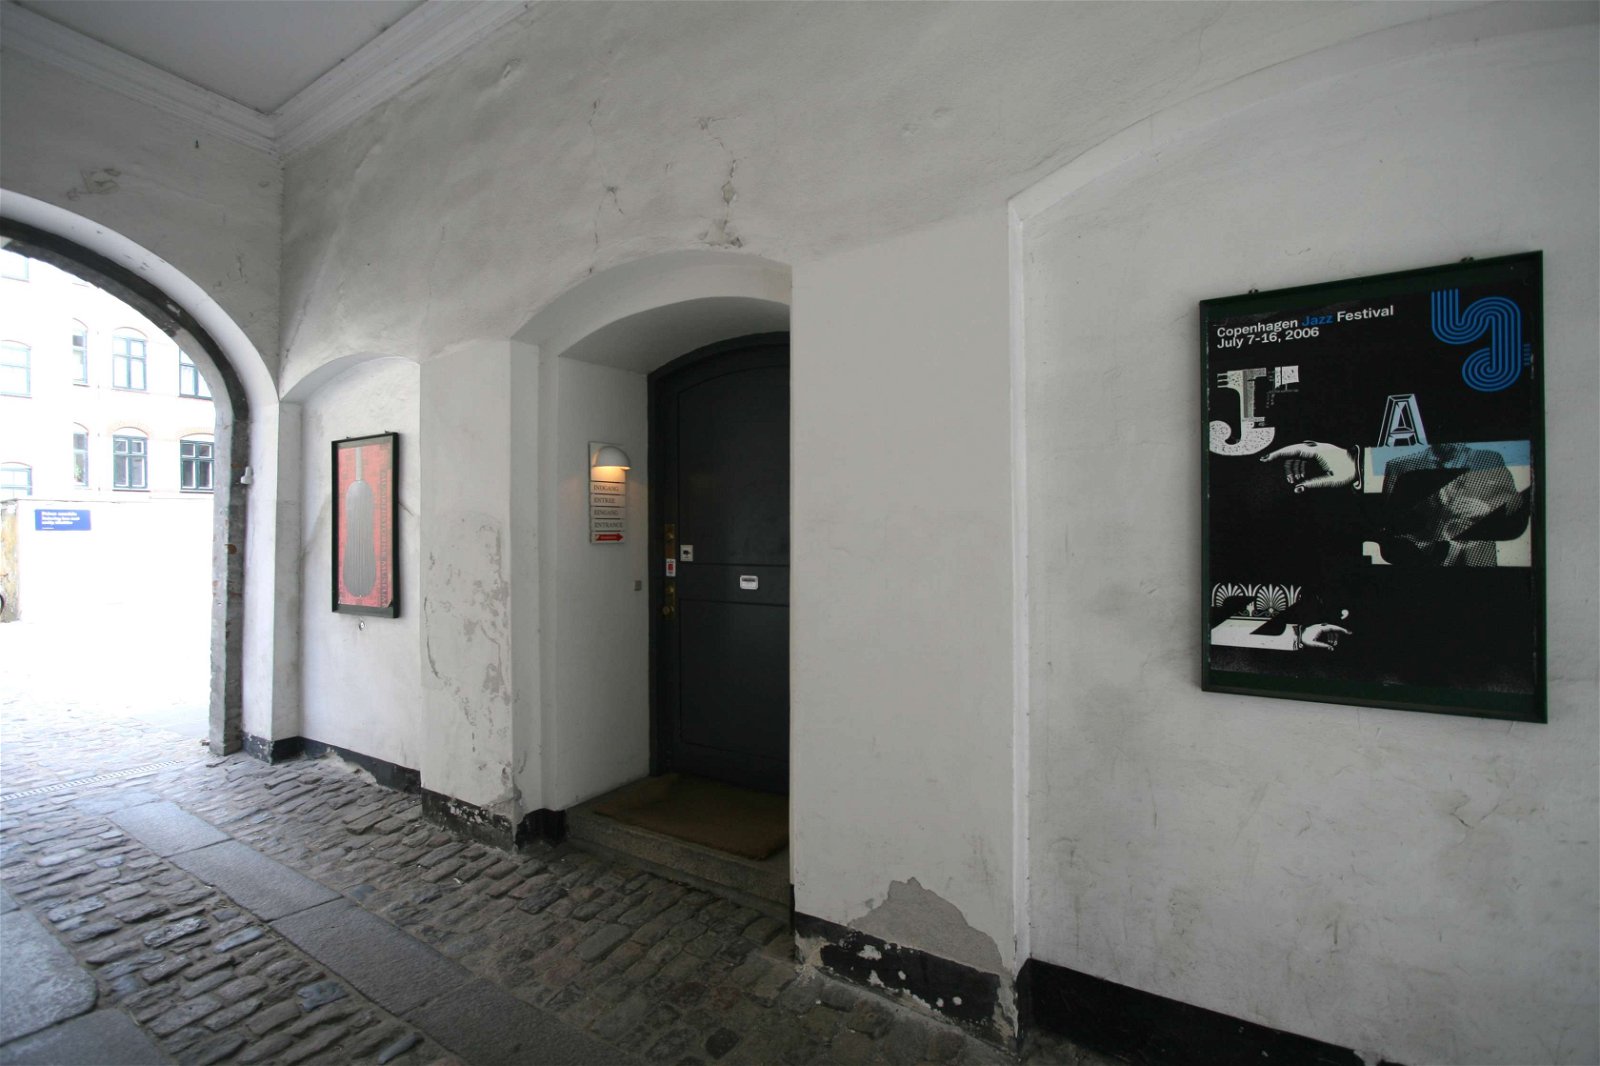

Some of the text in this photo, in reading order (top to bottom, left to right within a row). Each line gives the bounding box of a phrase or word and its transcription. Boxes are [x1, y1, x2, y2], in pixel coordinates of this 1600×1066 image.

[1216, 305, 1395, 338] Copenhagen Jazz Festival
[1216, 326, 1320, 350] July 7-16, 2006
[594, 521, 624, 529] ENTRANCE
